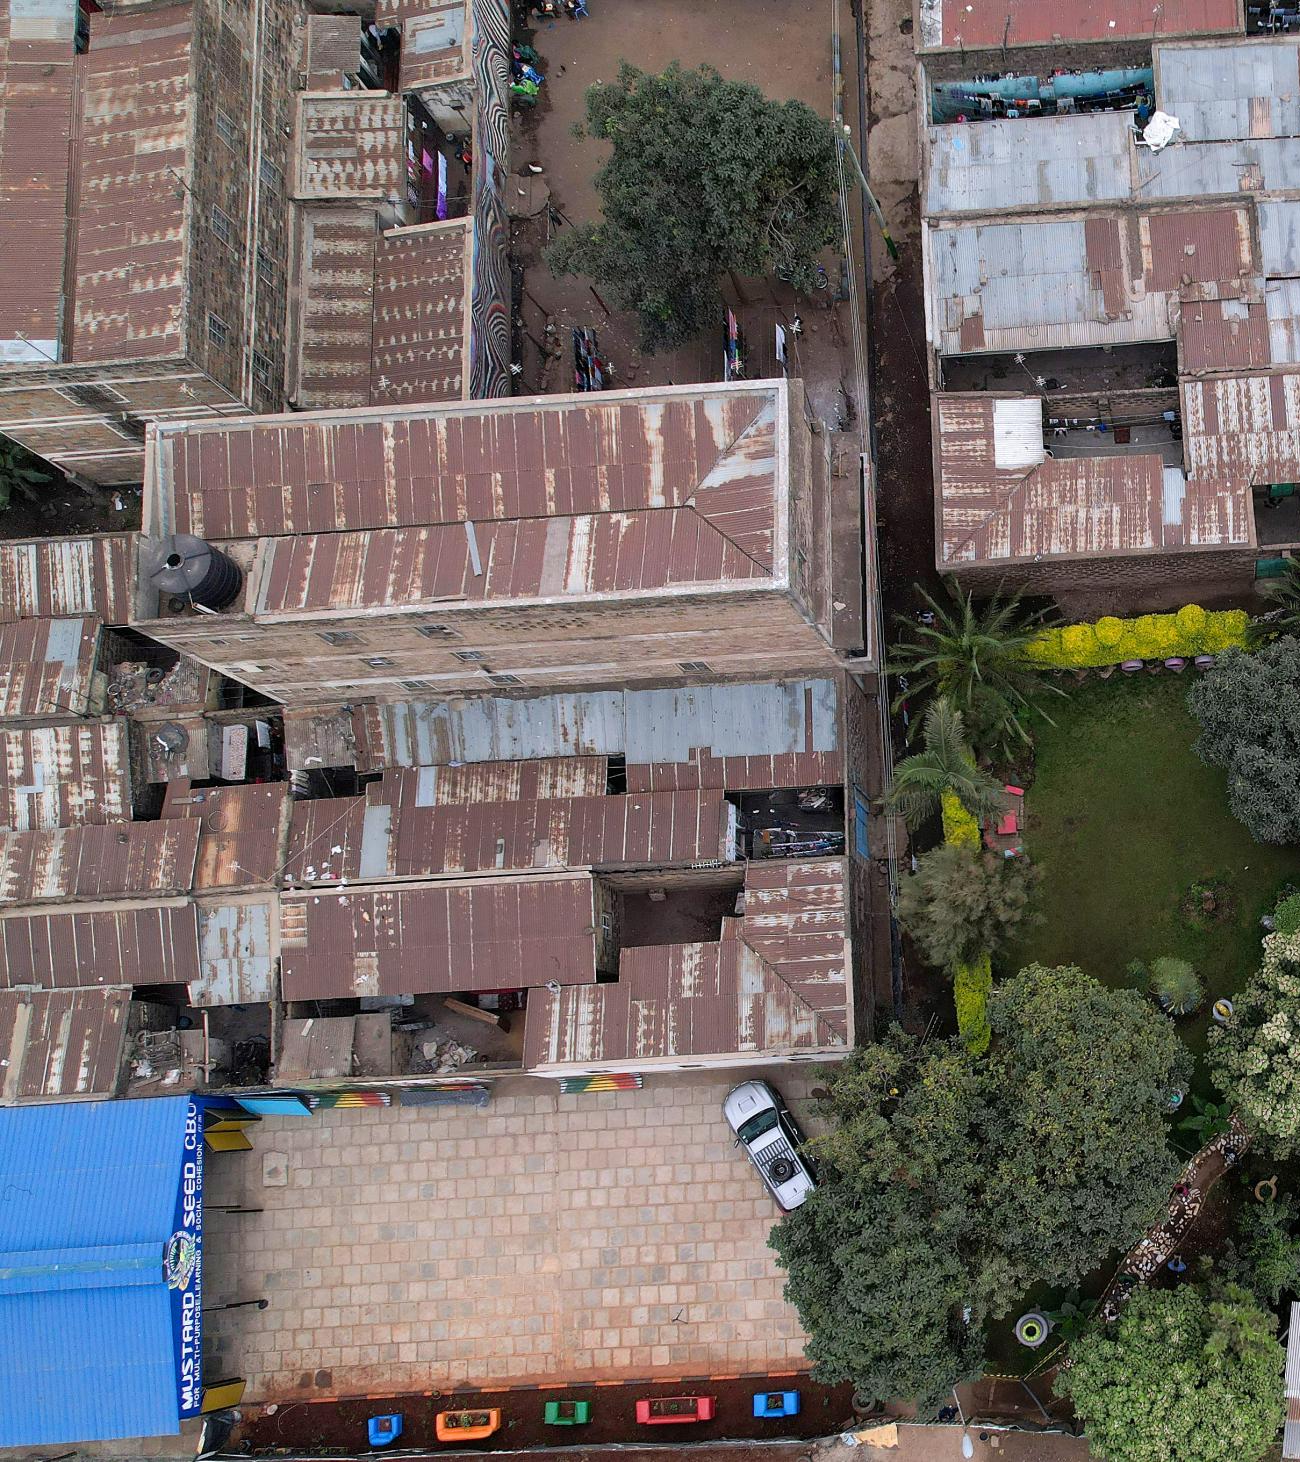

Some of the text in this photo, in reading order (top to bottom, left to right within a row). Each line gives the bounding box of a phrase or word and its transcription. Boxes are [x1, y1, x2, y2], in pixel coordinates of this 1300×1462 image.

[183, 1162, 196, 1228] SEED
[195, 1235, 202, 1244] &
[182, 1292, 194, 1410] MUSTARD
